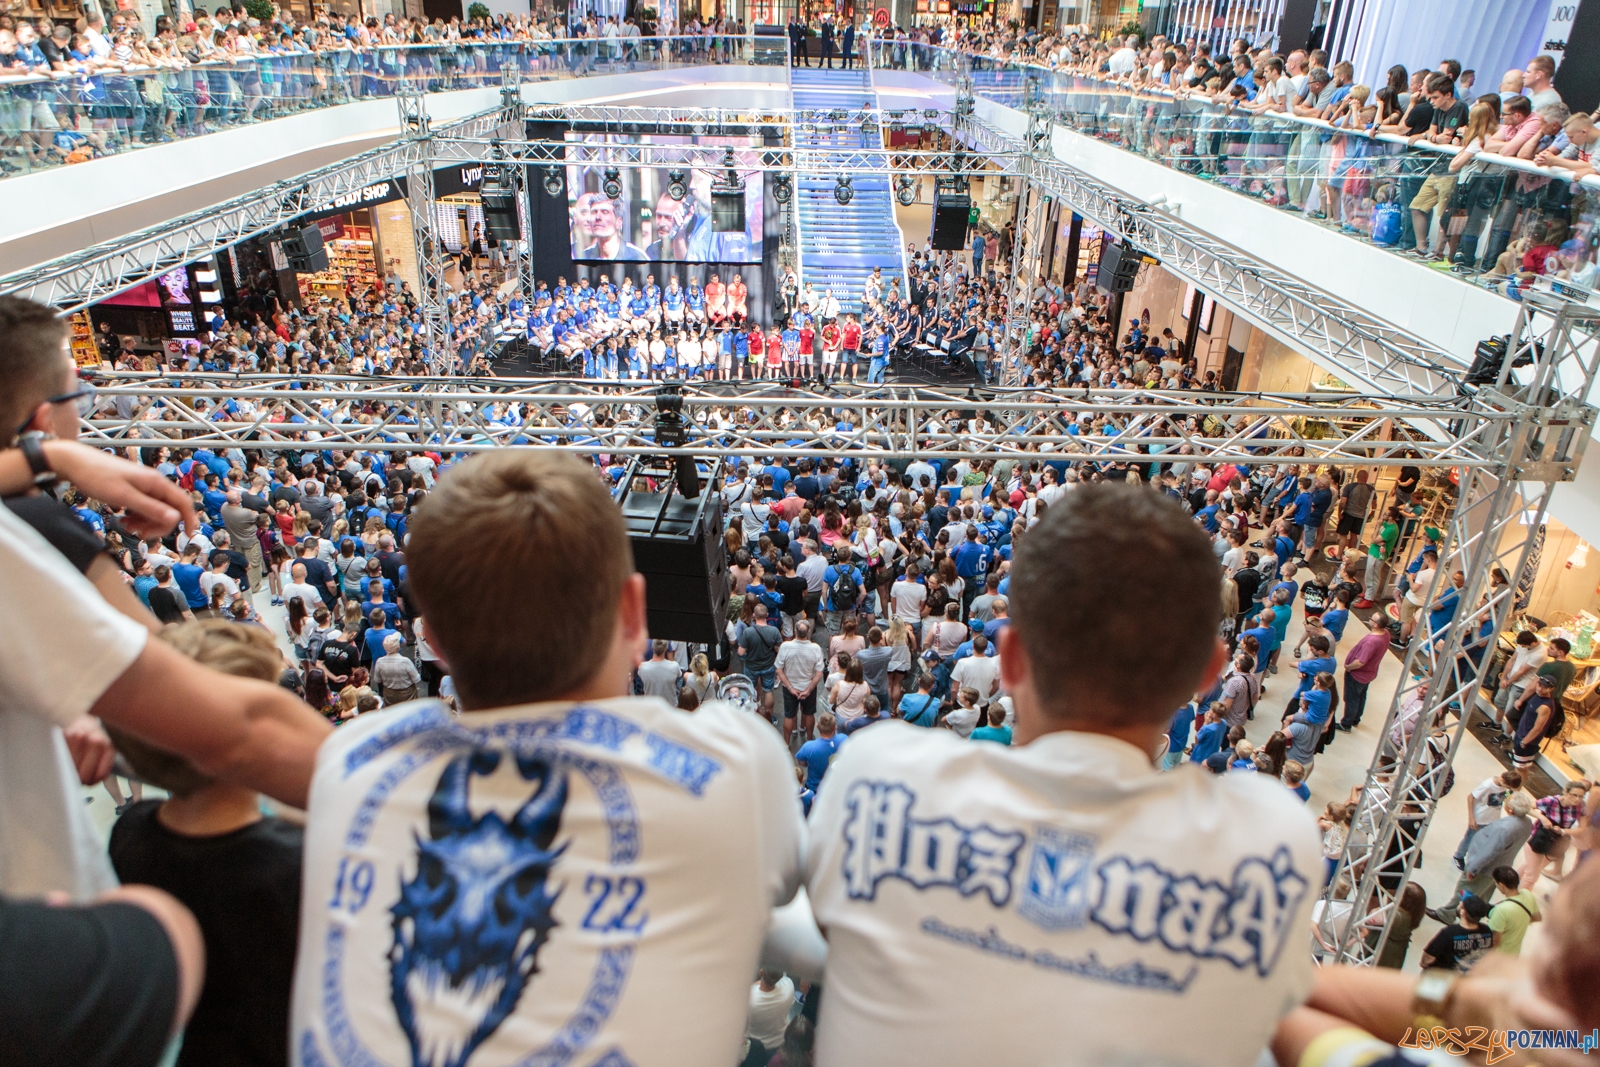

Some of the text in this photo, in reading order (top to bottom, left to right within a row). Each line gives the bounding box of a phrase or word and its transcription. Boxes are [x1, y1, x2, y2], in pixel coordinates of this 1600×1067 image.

[363, 182, 390, 201] SHOP
[173, 324, 196, 332] BEATS
[329, 857, 376, 914] 19
[579, 871, 650, 934] 22
